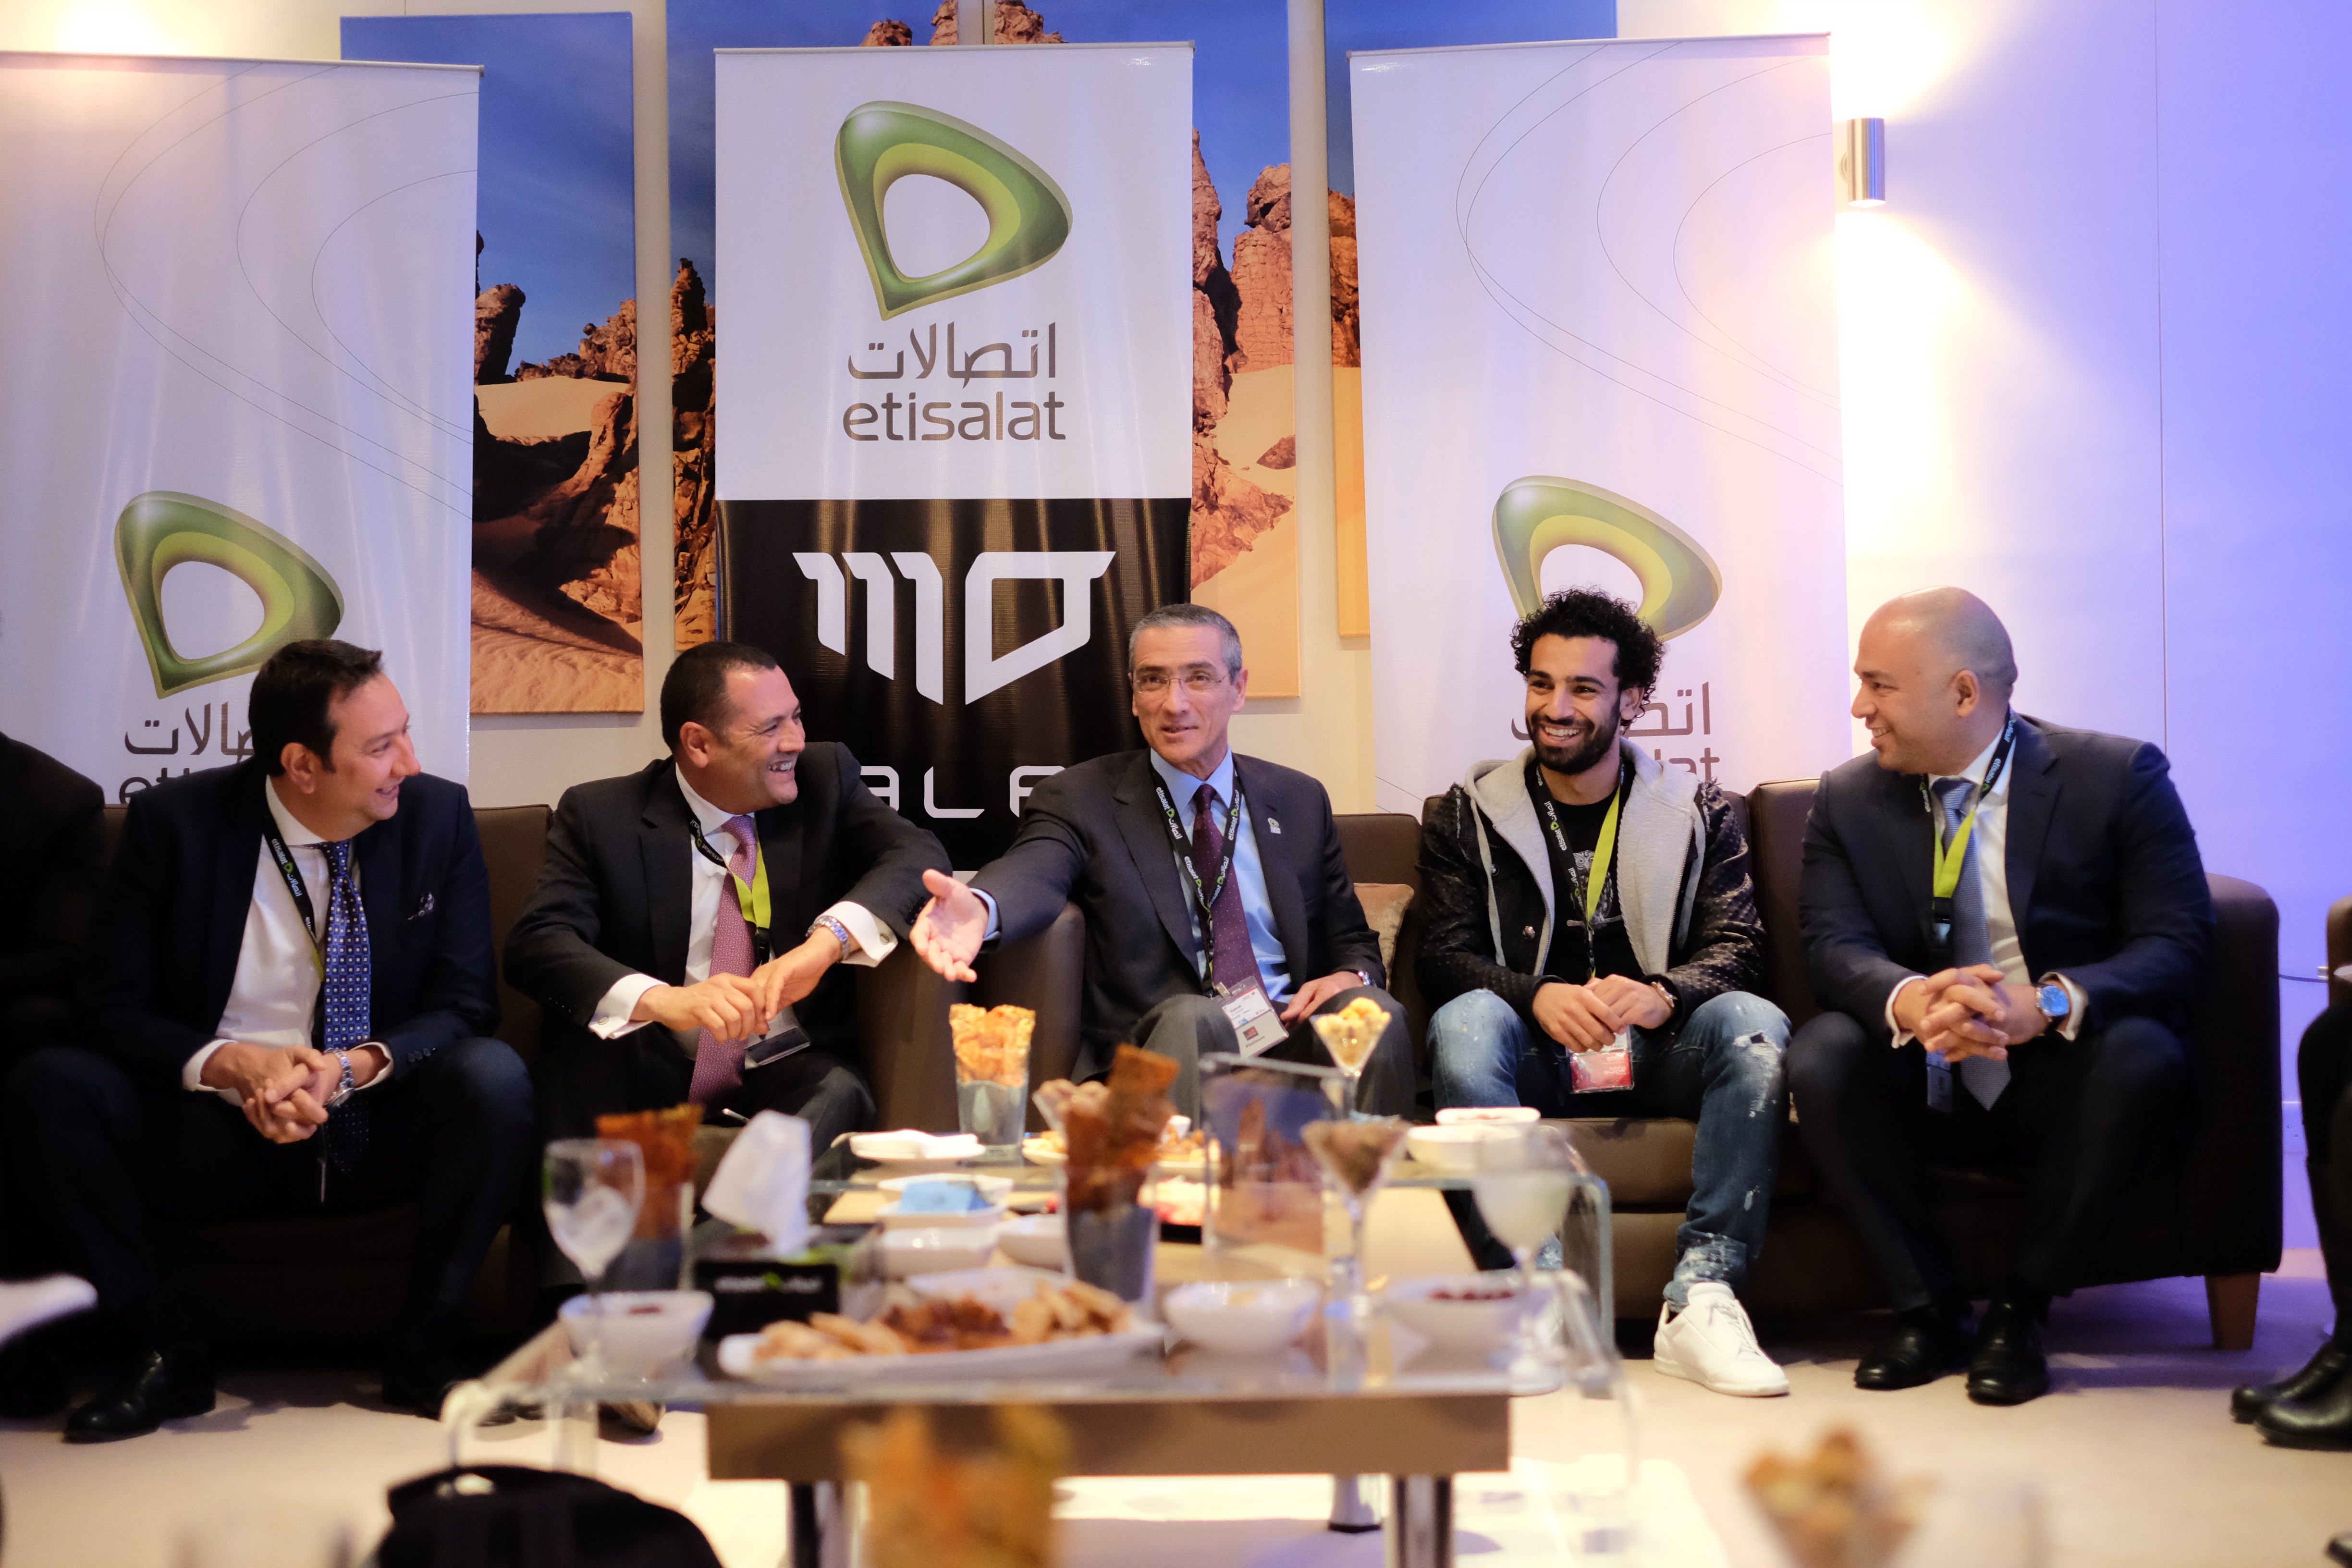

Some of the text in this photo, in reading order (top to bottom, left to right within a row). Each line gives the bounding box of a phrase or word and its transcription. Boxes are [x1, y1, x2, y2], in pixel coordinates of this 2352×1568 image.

[847, 321, 1056, 389] اتصالات
[843, 391, 1066, 441] etisalat
[860, 766, 1066, 819] ALA
[1156, 786, 1171, 811] etisalat
[1544, 801, 1557, 821] اتصالات
[1168, 818, 1183, 840] اتصالات
[1227, 816, 1238, 841] etisalat
[1554, 828, 1568, 851] etisalat
[271, 838, 289, 865] etisalat
